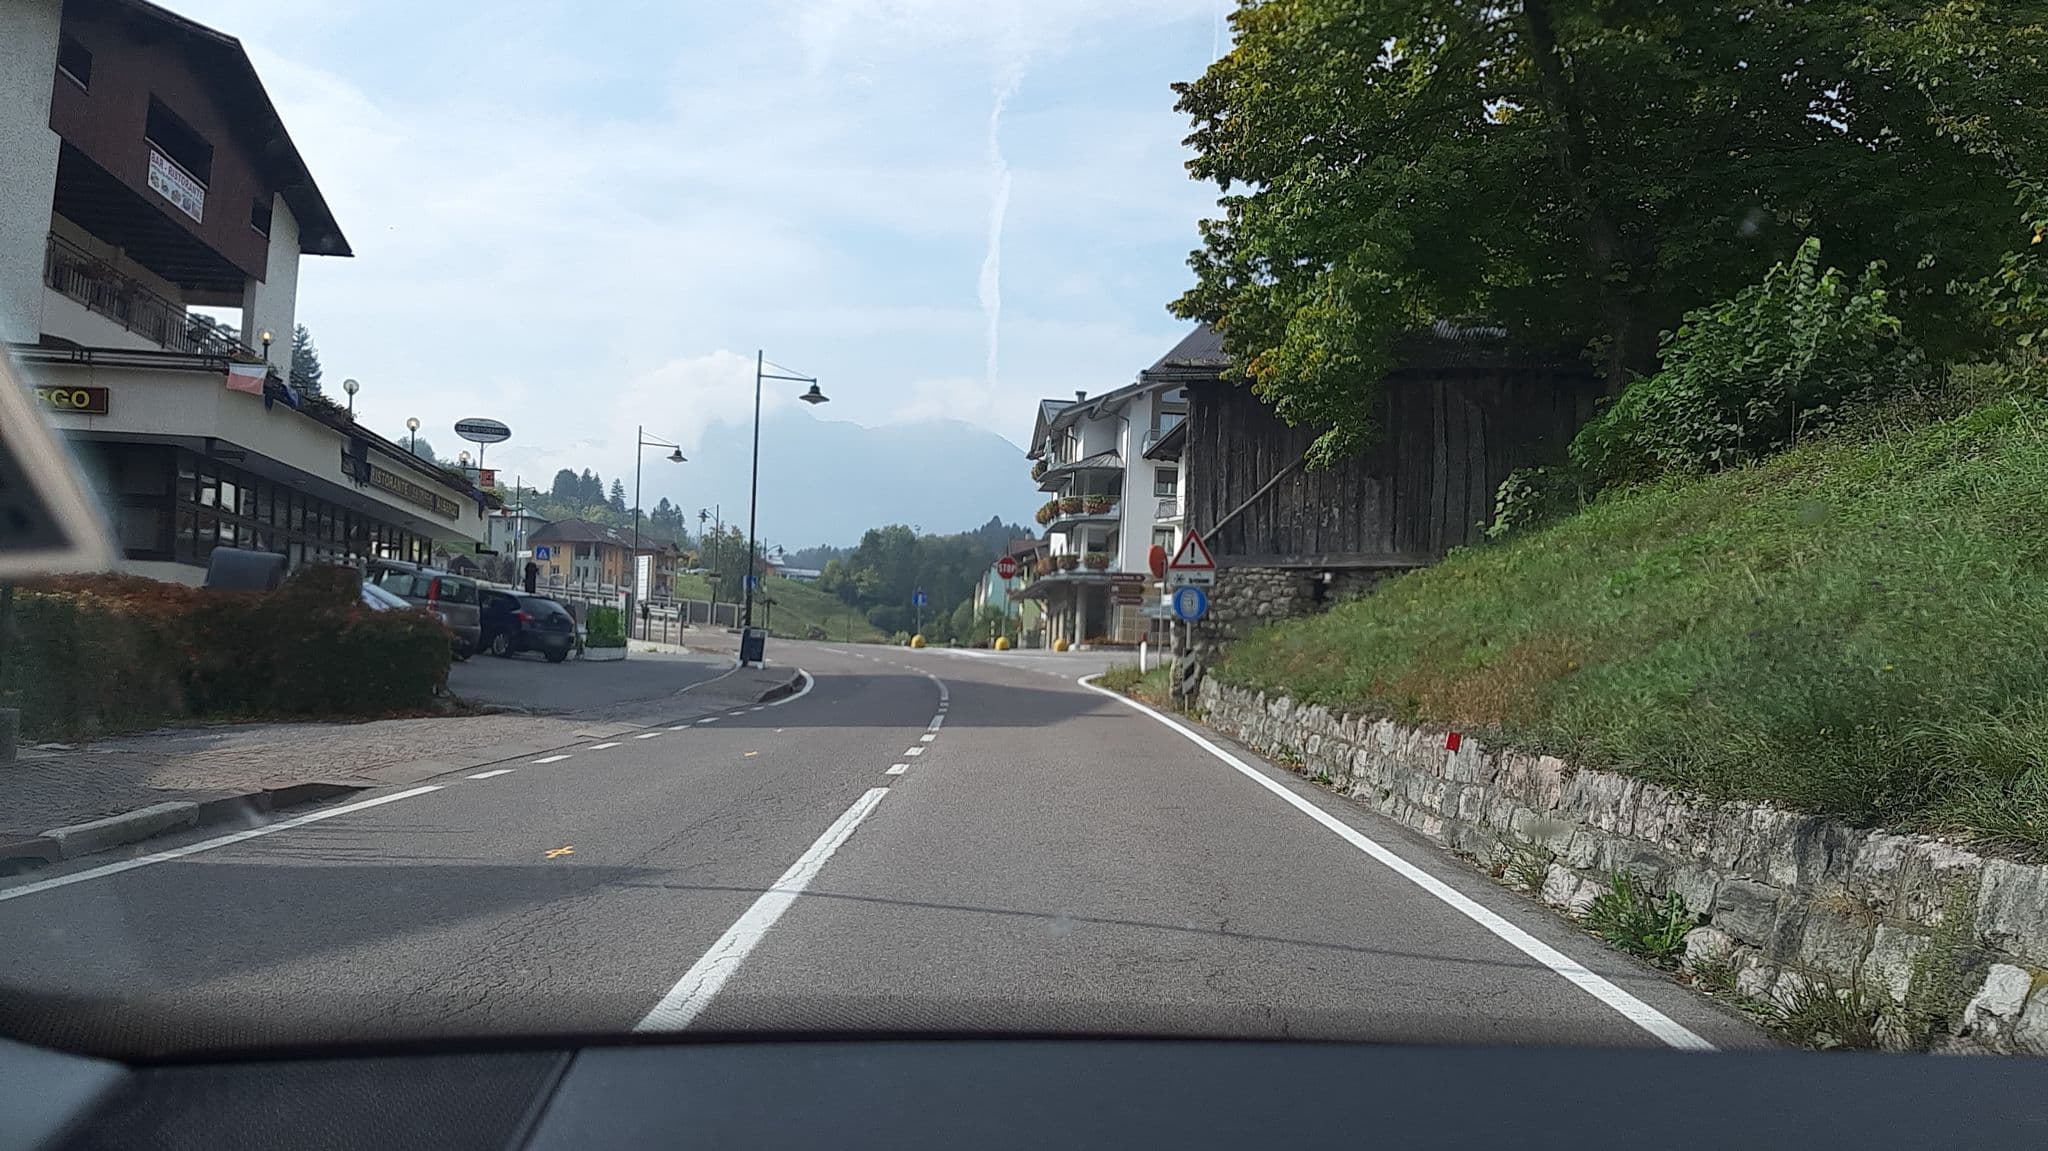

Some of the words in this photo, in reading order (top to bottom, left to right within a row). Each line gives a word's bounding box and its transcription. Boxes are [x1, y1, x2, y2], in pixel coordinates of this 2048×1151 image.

[152, 152, 164, 170] BAR
[167, 165, 204, 202] RISTORANTE
[998, 563, 1015, 574] STOP
